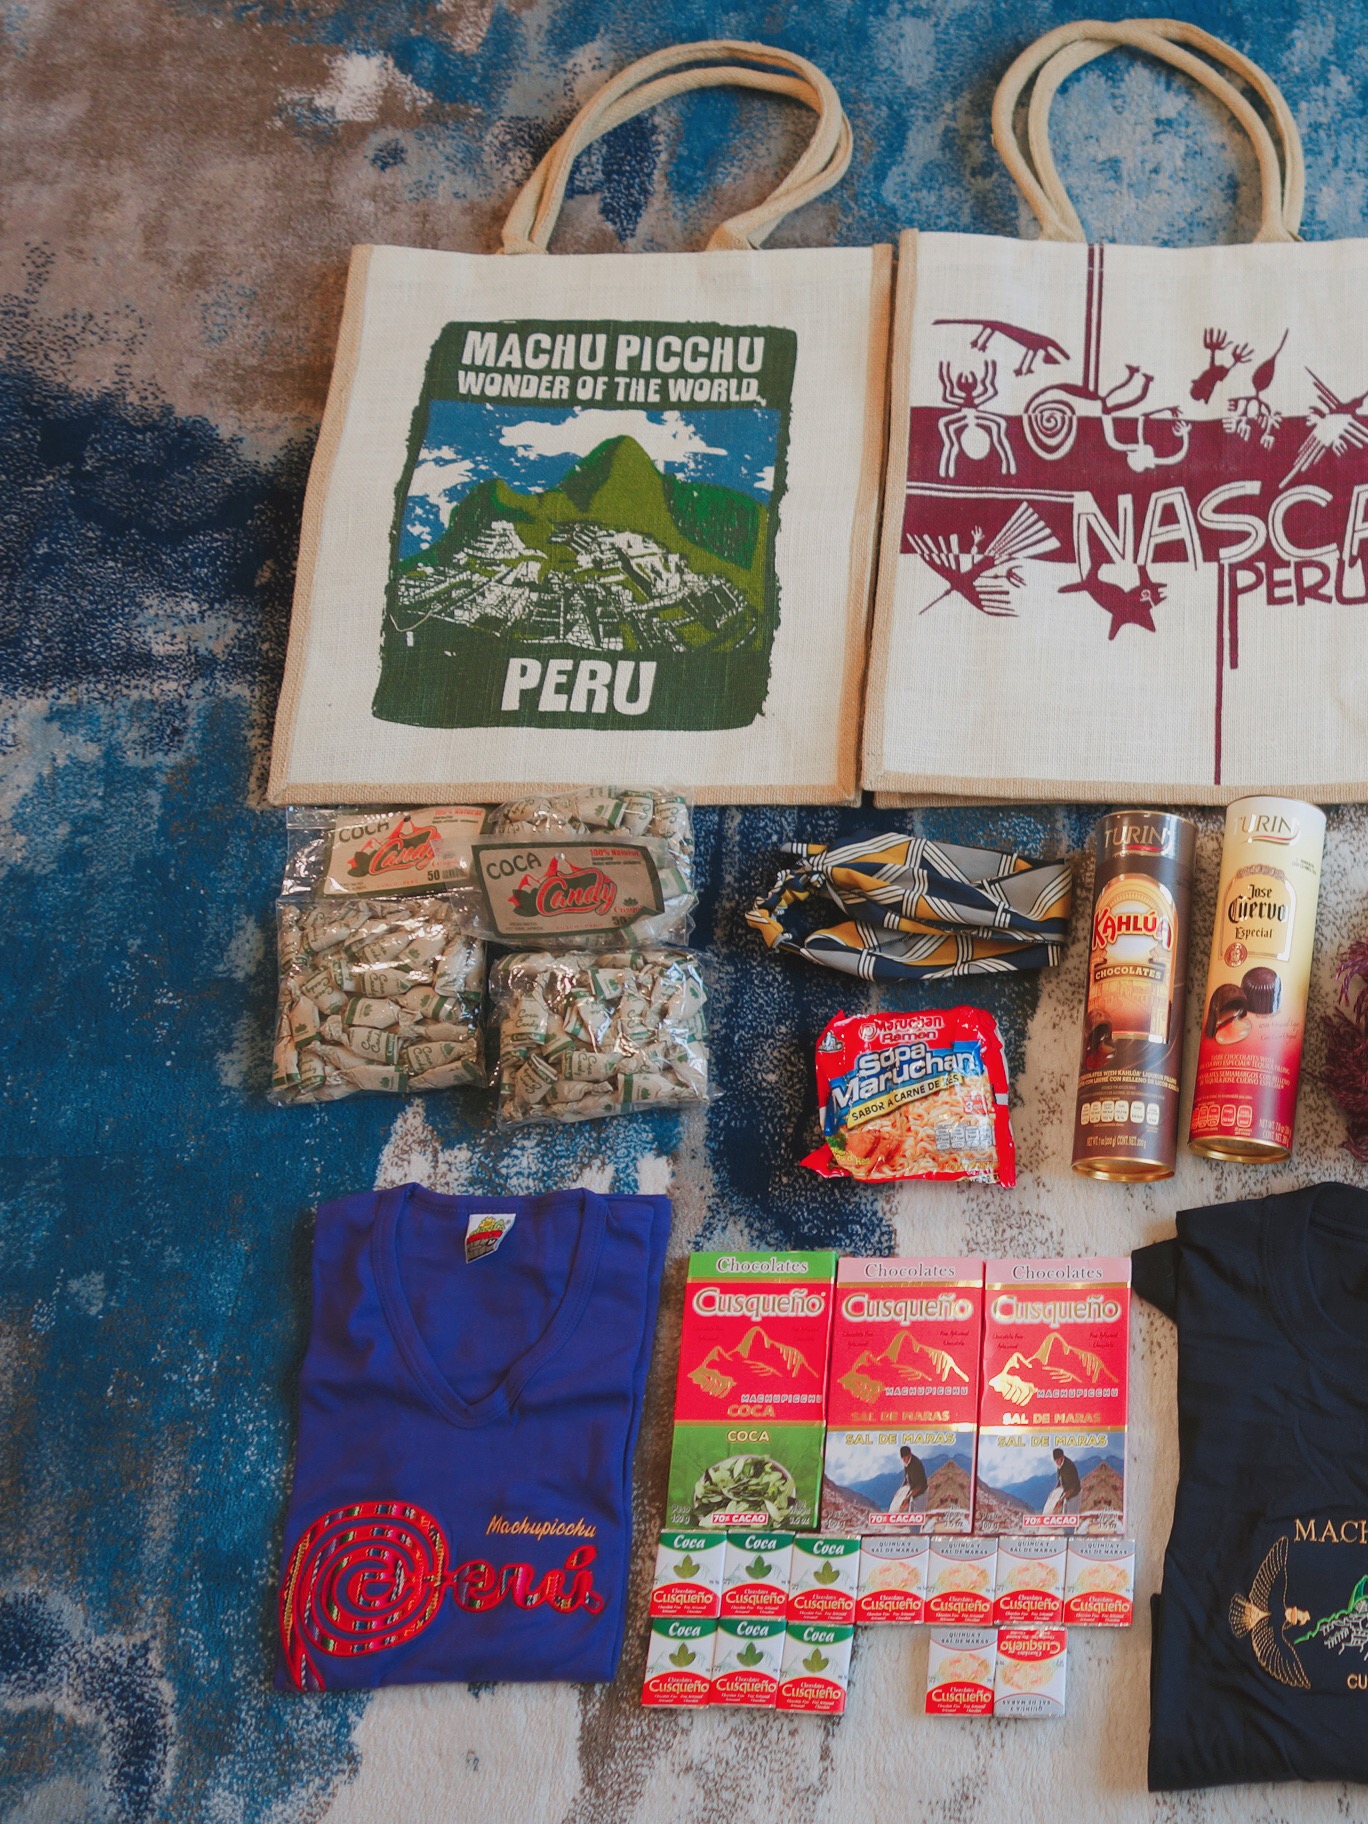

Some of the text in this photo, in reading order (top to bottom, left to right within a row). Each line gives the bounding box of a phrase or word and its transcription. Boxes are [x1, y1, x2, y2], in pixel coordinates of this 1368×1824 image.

[462, 331, 764, 373] MACHU PICCHU
[458, 370, 569, 399] WONDER
[577, 375, 608, 400] OF
[615, 377, 661, 402] THE
[501, 657, 656, 715] PERU
[1233, 815, 1293, 834] TURIN
[339, 822, 389, 843] COCA
[1104, 826, 1166, 848] TURIN
[486, 852, 541, 880] COCA
[427, 870, 440, 881] 50
[536, 867, 617, 917] Candy
[1248, 884, 1272, 900] Jose
[1228, 895, 1288, 924] Cuervo
[612, 916, 627, 925] 50
[1092, 905, 1172, 951] KAHLÚA
[1235, 927, 1272, 940] Especial
[1094, 965, 1162, 980] CHOCOLATES
[875, 1016, 944, 1031] Maruchan
[880, 1030, 938, 1044] Ramen
[859, 1043, 927, 1077] Sopa
[832, 1051, 975, 1110] Maruchan
[852, 1101, 885, 1121] SABOR
[887, 1099, 893, 1108] A
[894, 1083, 926, 1103] CARNE
[928, 1080, 940, 1091] DE
[965, 1100, 974, 1112] 3
[717, 1256, 808, 1273] Chocolates
[864, 1262, 955, 1279] Chocolates
[1012, 1264, 1102, 1280] Chocolates
[693, 1287, 826, 1321] Cusqueño
[842, 1293, 973, 1326] Cusqueño
[992, 1295, 1121, 1328] Cusqueño
[885, 1386, 969, 1396] MACHUPICCHU
[1037, 1388, 1119, 1398] MACHUPICCHU
[741, 1394, 822, 1404] MACHUPICCHU
[728, 1404, 774, 1417] COCA
[851, 1411, 950, 1421] SAL DE MARAS
[1003, 1413, 1101, 1424] SAL DE MARAS
[727, 1430, 770, 1443] COCA
[845, 1433, 956, 1445] SAL DE MARAS
[997, 1435, 1108, 1447] SAL DE MARAS
[486, 1514, 598, 1539] Machupicchu
[713, 1514, 766, 1524] 70% CACAO
[870, 1514, 923, 1524] 70% CACAO
[1025, 1516, 1077, 1526] 70% CACAO
[673, 1534, 705, 1549] Coca
[745, 1535, 776, 1550] Coca
[813, 1540, 844, 1555] Coca
[653, 1590, 713, 1605] Cusqueño
[726, 1590, 786, 1605] Cusqueño
[794, 1596, 854, 1611] Cusqueño
[861, 1597, 921, 1612] Cusqueño
[1000, 1597, 1059, 1611] Cusqueño
[930, 1599, 990, 1613] Cusqueño
[1070, 1599, 1130, 1613] Cusqueño
[668, 1621, 701, 1636] Coca
[736, 1621, 769, 1636] Coca
[803, 1627, 835, 1642] Coca
[1001, 1640, 1060, 1654] Cusqueño
[649, 1679, 709, 1694] Cusqueño
[716, 1679, 777, 1694] Cusqueño
[782, 1684, 841, 1699] Cusqueño
[932, 1689, 992, 1704] Cusqueño
